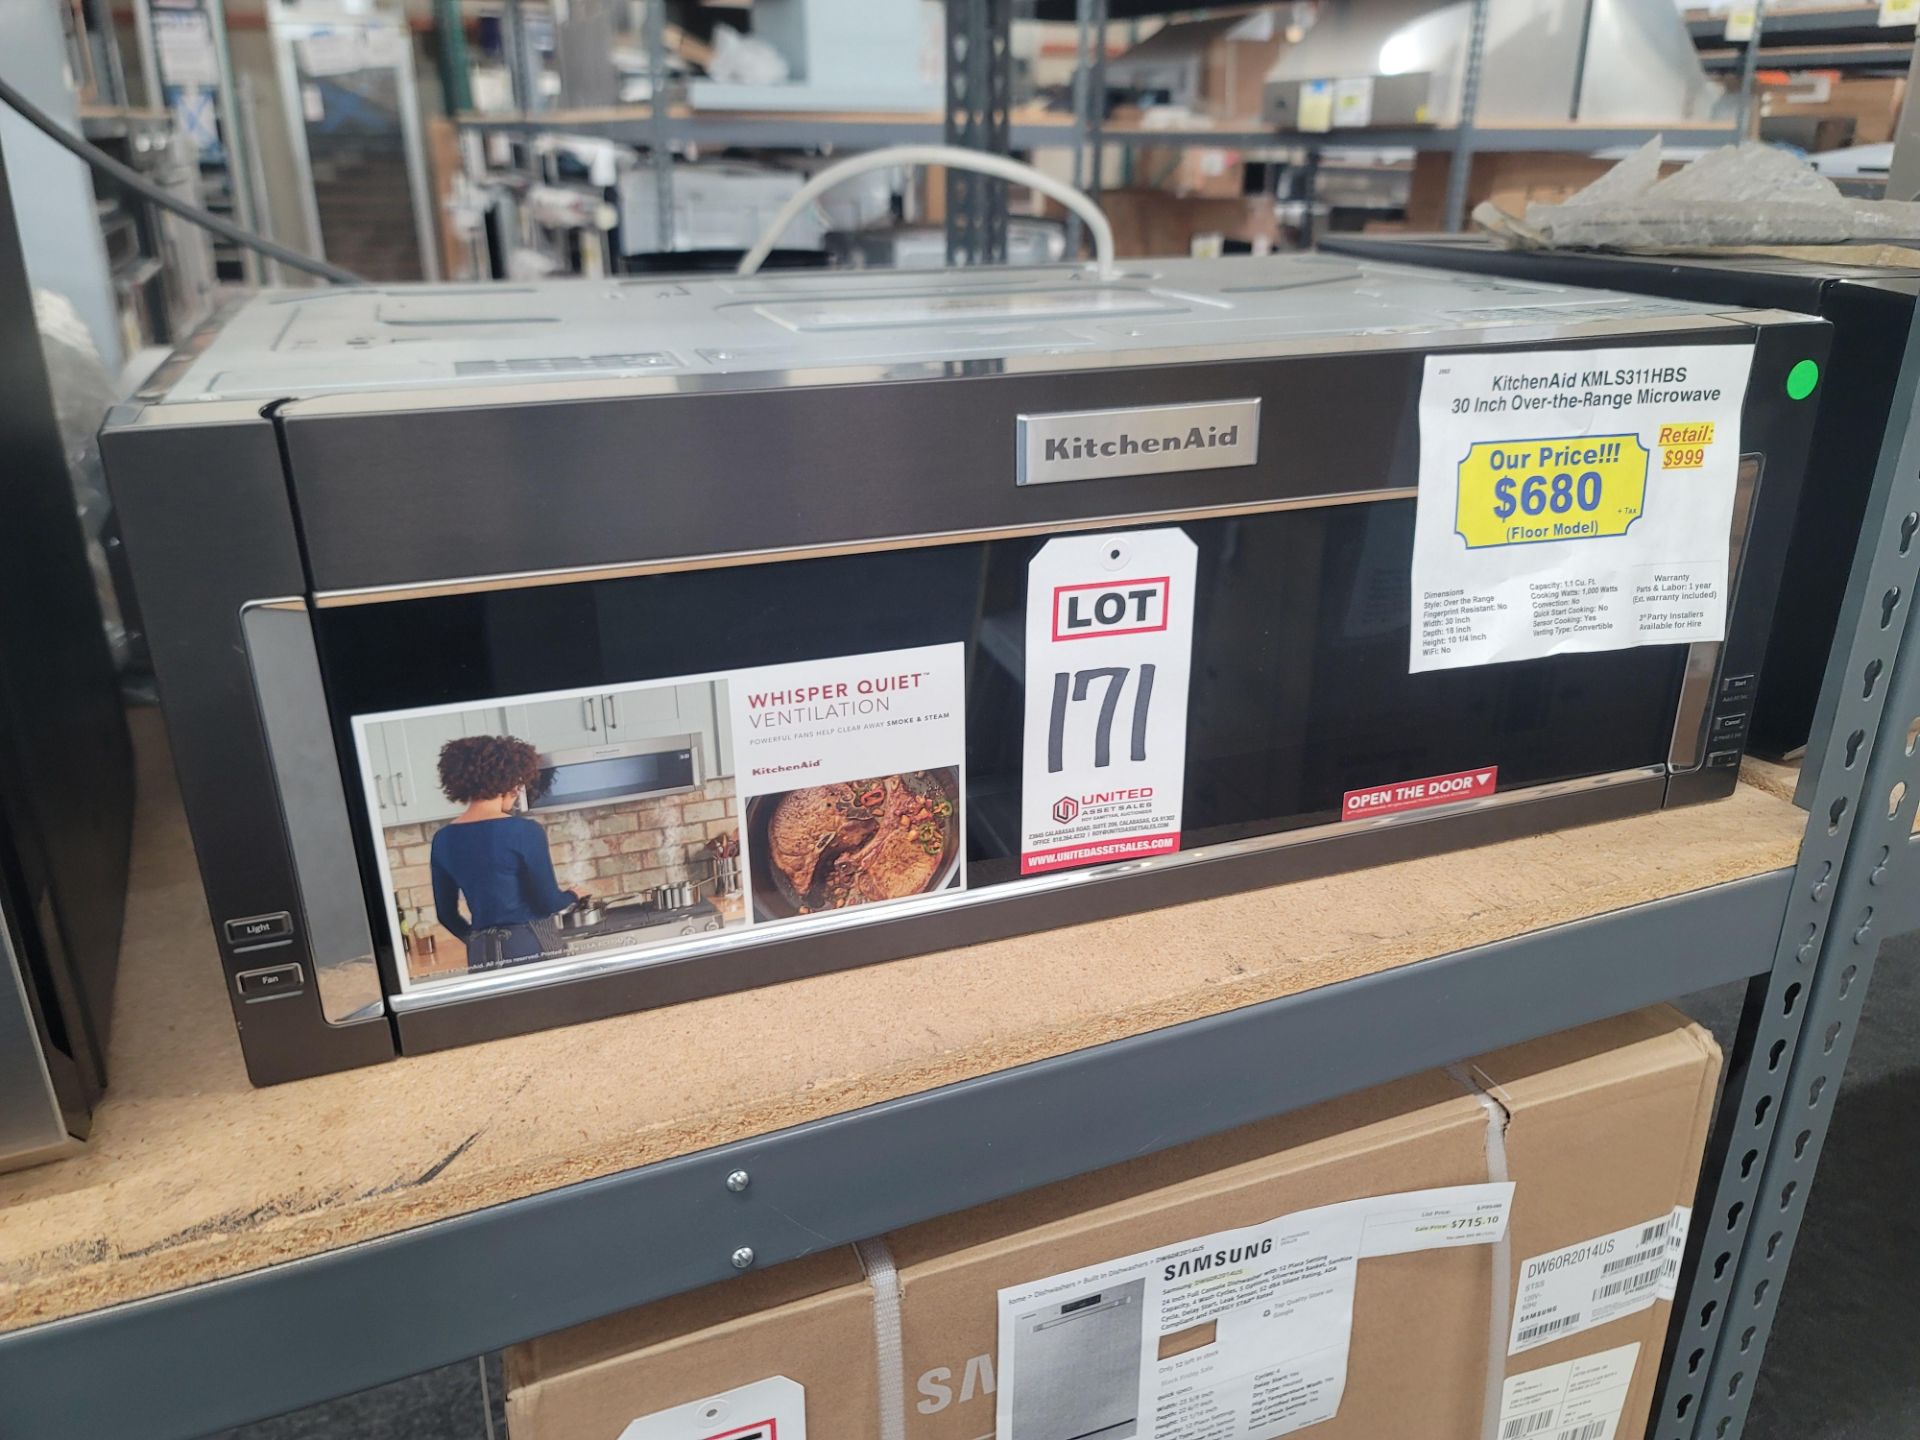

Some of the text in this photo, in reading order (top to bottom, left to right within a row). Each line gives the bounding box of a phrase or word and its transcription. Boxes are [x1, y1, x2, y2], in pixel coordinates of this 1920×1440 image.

[1493, 367, 1687, 392] KitchenAid KMLS311HBS
[1452, 388, 1721, 413] 30 Inch Over-the-Range Microwave
[1659, 427, 1713, 443] Retail:
[1045, 426, 1238, 461] KitchenAid
[1490, 443, 1621, 470] Our Price!!!
[1664, 448, 1704, 467] $999
[1494, 472, 1602, 523] $680
[1507, 521, 1598, 544] (Floor Model)
[1654, 574, 1690, 582] Warranty
[1696, 582, 1711, 590] year
[1424, 589, 1464, 599] Dimensions
[1647, 594, 1679, 602] warranty
[1681, 591, 1717, 600] included)
[1067, 589, 1156, 629] LOT
[1424, 601, 1441, 609] Style:
[1444, 599, 1459, 607] Over
[1473, 596, 1494, 604] Range
[1424, 603, 1507, 618] Fingerprint Resistant: No
[1423, 619, 1443, 628] Width:
[1648, 613, 1667, 621] Party
[1670, 611, 1703, 619] Installers
[1423, 629, 1443, 637] Depth:
[1573, 623, 1613, 631] Convertible
[1640, 622, 1672, 631] Available
[1423, 638, 1446, 647] Height:
[748, 683, 848, 709] WHISPER
[749, 696, 890, 729] VENTILATION
[1048, 664, 1156, 773] 171
[750, 734, 792, 745] POWERFUL
[795, 731, 813, 740] FANS
[816, 728, 835, 737] HELP
[837, 724, 861, 734] CLEAR
[864, 722, 884, 730] AWAY
[887, 717, 913, 727] SMOKE
[925, 713, 950, 722] STEAM
[752, 759, 822, 777] KitchenAid
[1082, 787, 1153, 805] UNITED
[1348, 791, 1391, 809] OPEN
[1396, 785, 1424, 800] THE
[1429, 777, 1472, 795] DOOR
[1082, 802, 1152, 816] ASSET SALES
[1045, 828, 1074, 836] CALABASAS
[1033, 838, 1049, 846] OFFICE
[1028, 838, 1173, 866] WWW.UNITEDASSETSALES.COM
[247, 922, 270, 936] Light
[262, 974, 278, 984] Fan
[1452, 1216, 1498, 1228] $715.10
[1164, 1238, 1272, 1281] SAMSUNG
[1528, 1239, 1615, 1278] DW60R2014US
[1520, 1306, 1557, 1323] SAMSUNG
